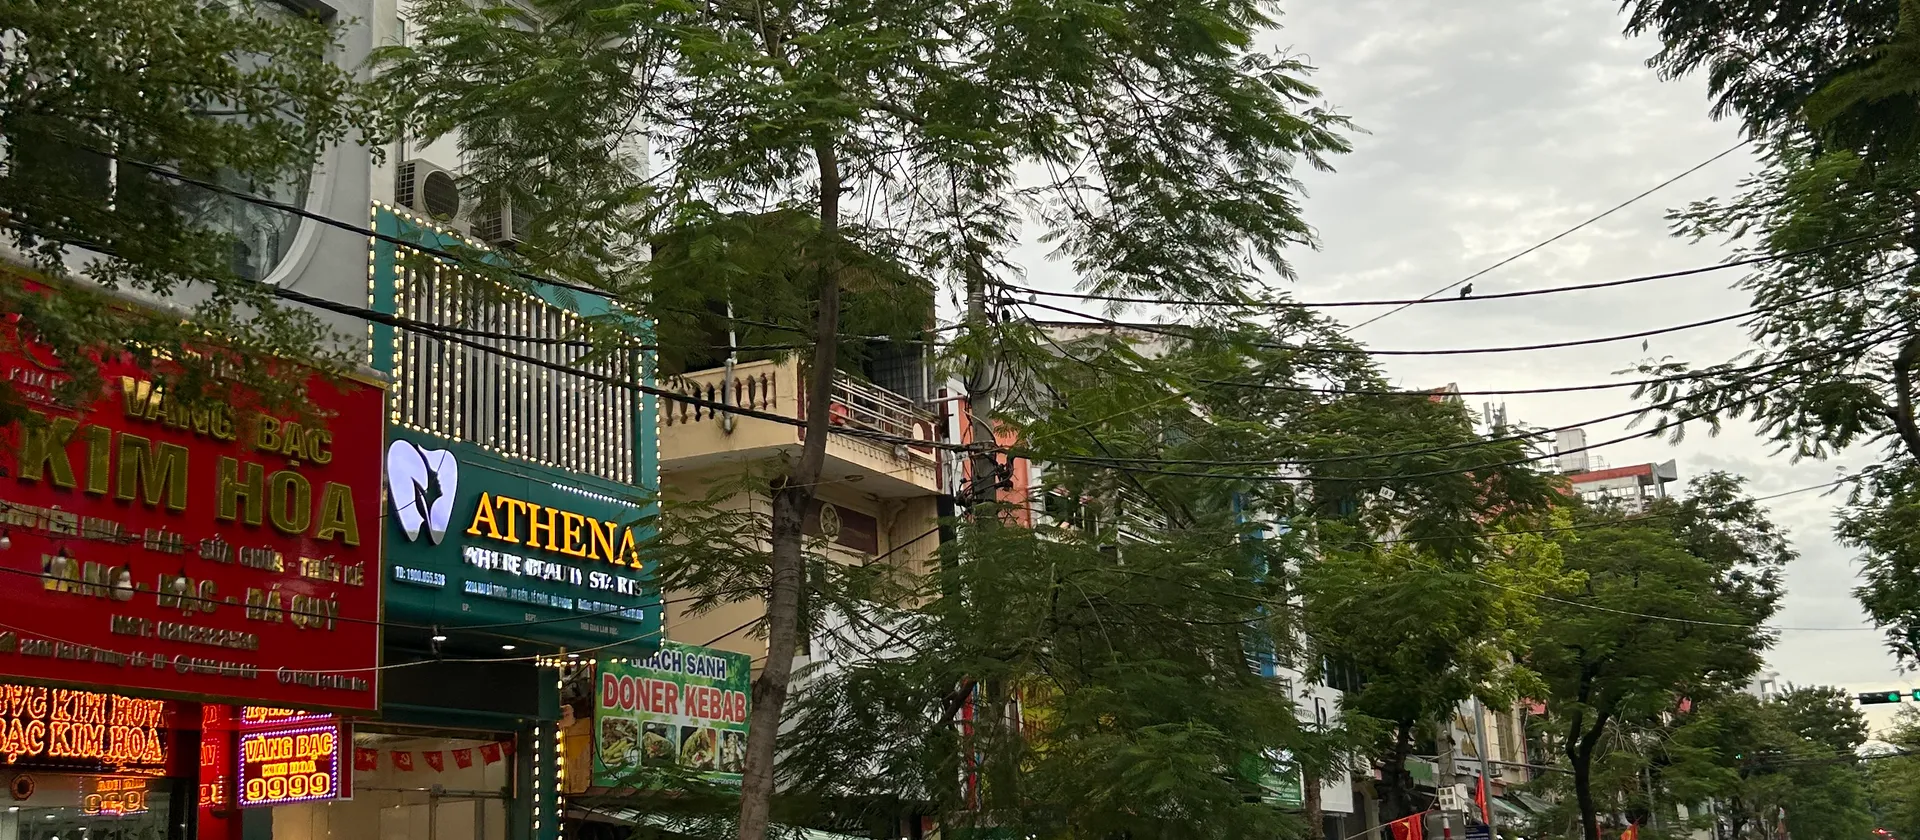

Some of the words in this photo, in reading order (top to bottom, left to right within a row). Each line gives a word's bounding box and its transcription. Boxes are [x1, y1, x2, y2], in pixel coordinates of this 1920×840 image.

[257, 413, 333, 467] BẠC
[18, 409, 189, 511] KIM
[466, 491, 643, 569] ATHENA
[685, 652, 727, 681] SANH
[602, 672, 679, 715] DONER
[684, 683, 747, 724] KEBAB
[48, 721, 106, 757] KIM
[245, 735, 293, 763] VÀNG
[296, 732, 334, 760] BẠC
[246, 773, 331, 801] 9999
[262, 763, 288, 777] KIM
